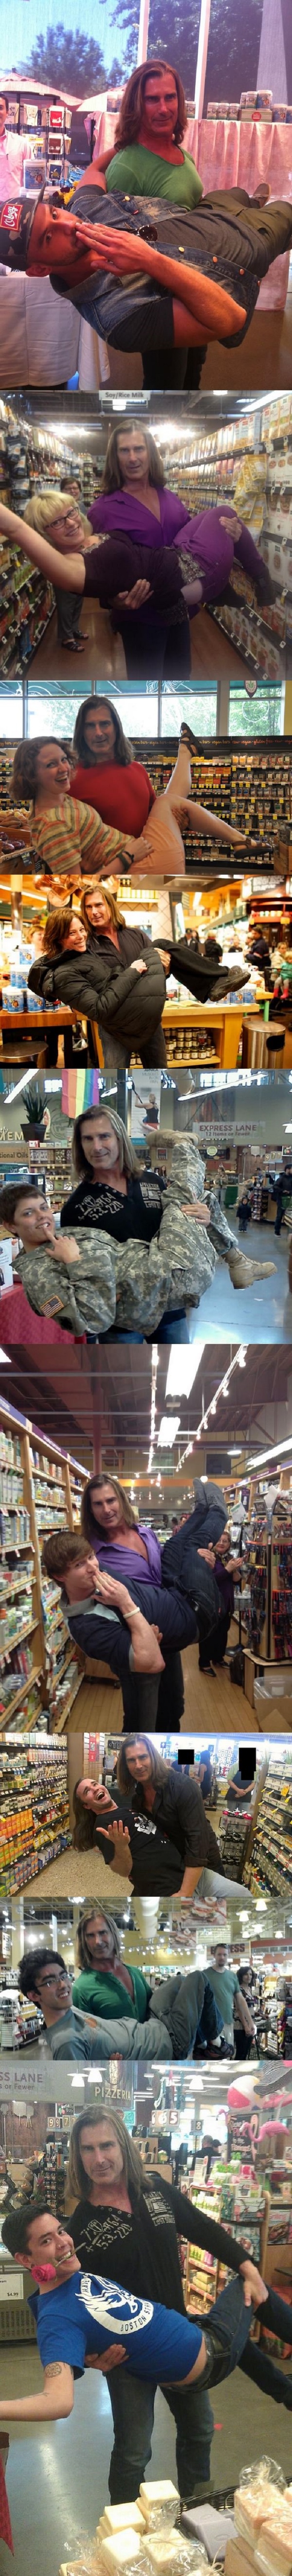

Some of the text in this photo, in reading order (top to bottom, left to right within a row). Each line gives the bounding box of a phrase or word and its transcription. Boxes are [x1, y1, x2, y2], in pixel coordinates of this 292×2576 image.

[3, 206, 18, 227] Obey
[14, 2073, 43, 2082] LANE
[94, 2086, 131, 2101] PIZZERIA
[49, 2118, 54, 2127] 9
[169, 2112, 178, 2125] 5
[196, 2121, 201, 2130] 8
[120, 2316, 146, 2332] BOSTON
